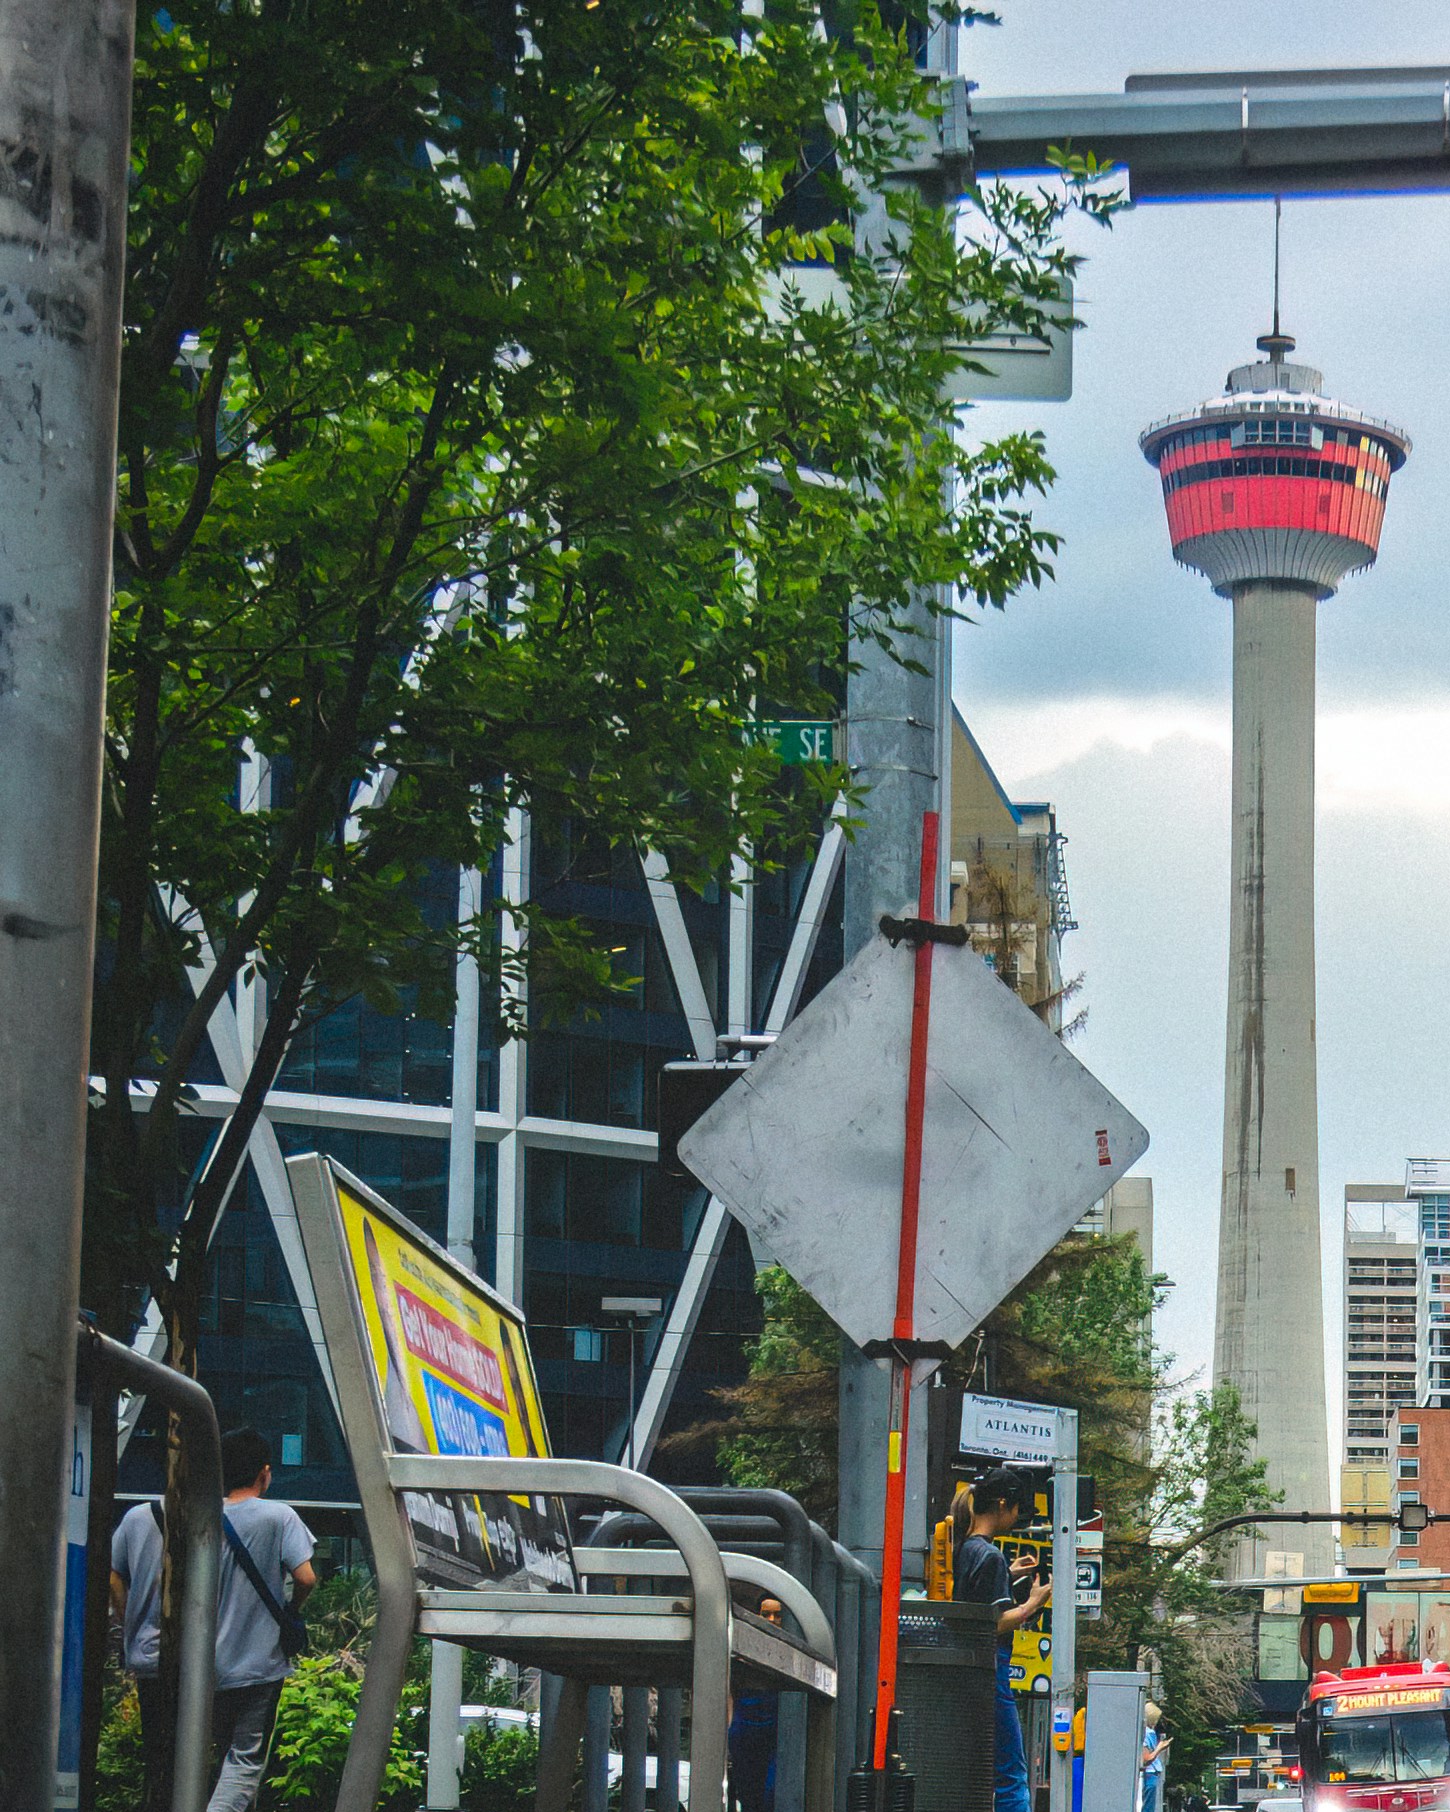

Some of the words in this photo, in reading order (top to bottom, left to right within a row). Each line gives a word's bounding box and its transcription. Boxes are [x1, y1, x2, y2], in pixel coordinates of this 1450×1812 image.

[799, 727, 827, 760] SE
[985, 1419, 1051, 1438] ATLANTIS
[1337, 1695, 1349, 1713] 2
[1349, 1693, 1385, 1709] MOUNT
[1388, 1689, 1441, 1705] PLEASANT
